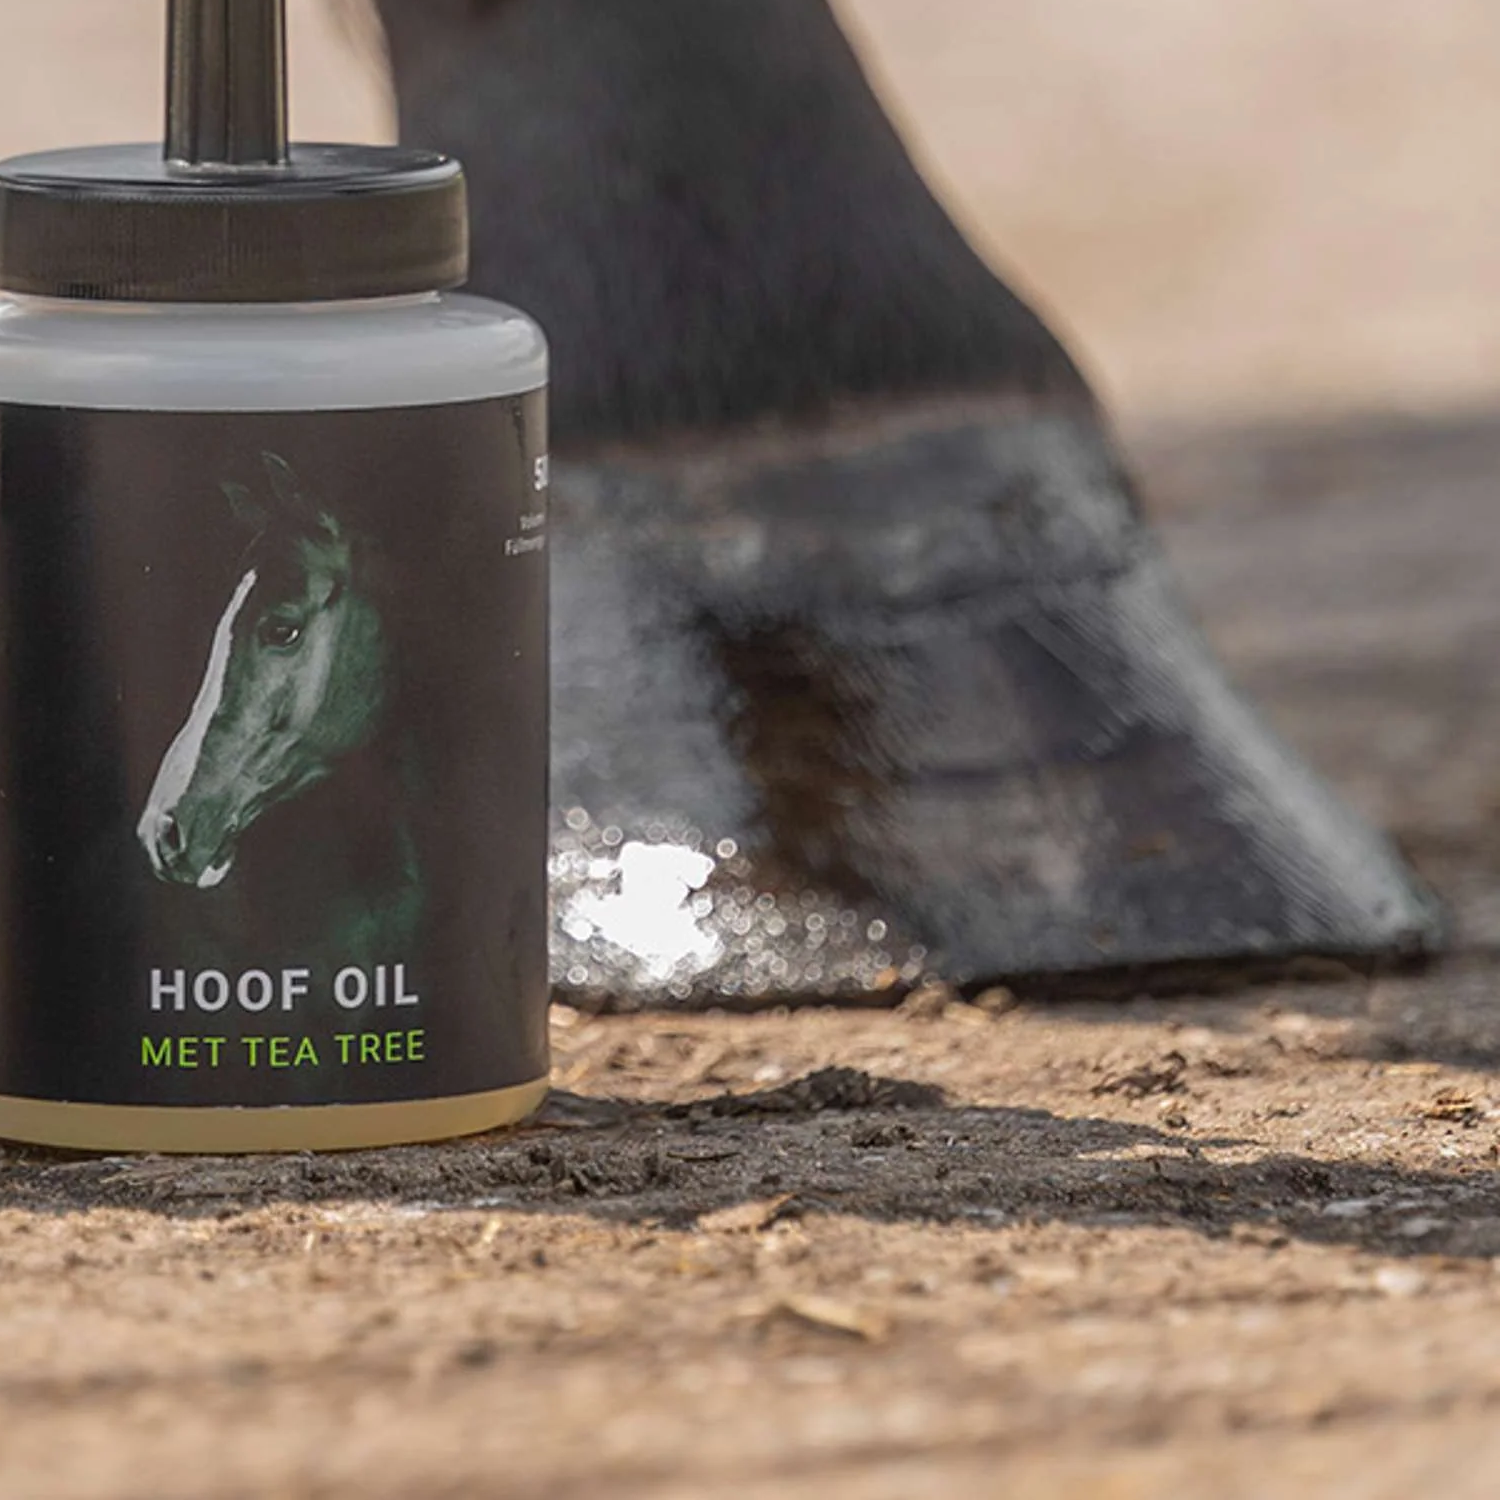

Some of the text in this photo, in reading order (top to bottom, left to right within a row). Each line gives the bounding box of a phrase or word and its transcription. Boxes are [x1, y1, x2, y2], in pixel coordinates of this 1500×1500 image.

[150, 964, 419, 1011] HOOF OIL
[141, 1029, 425, 1067] MET TEA TREE
